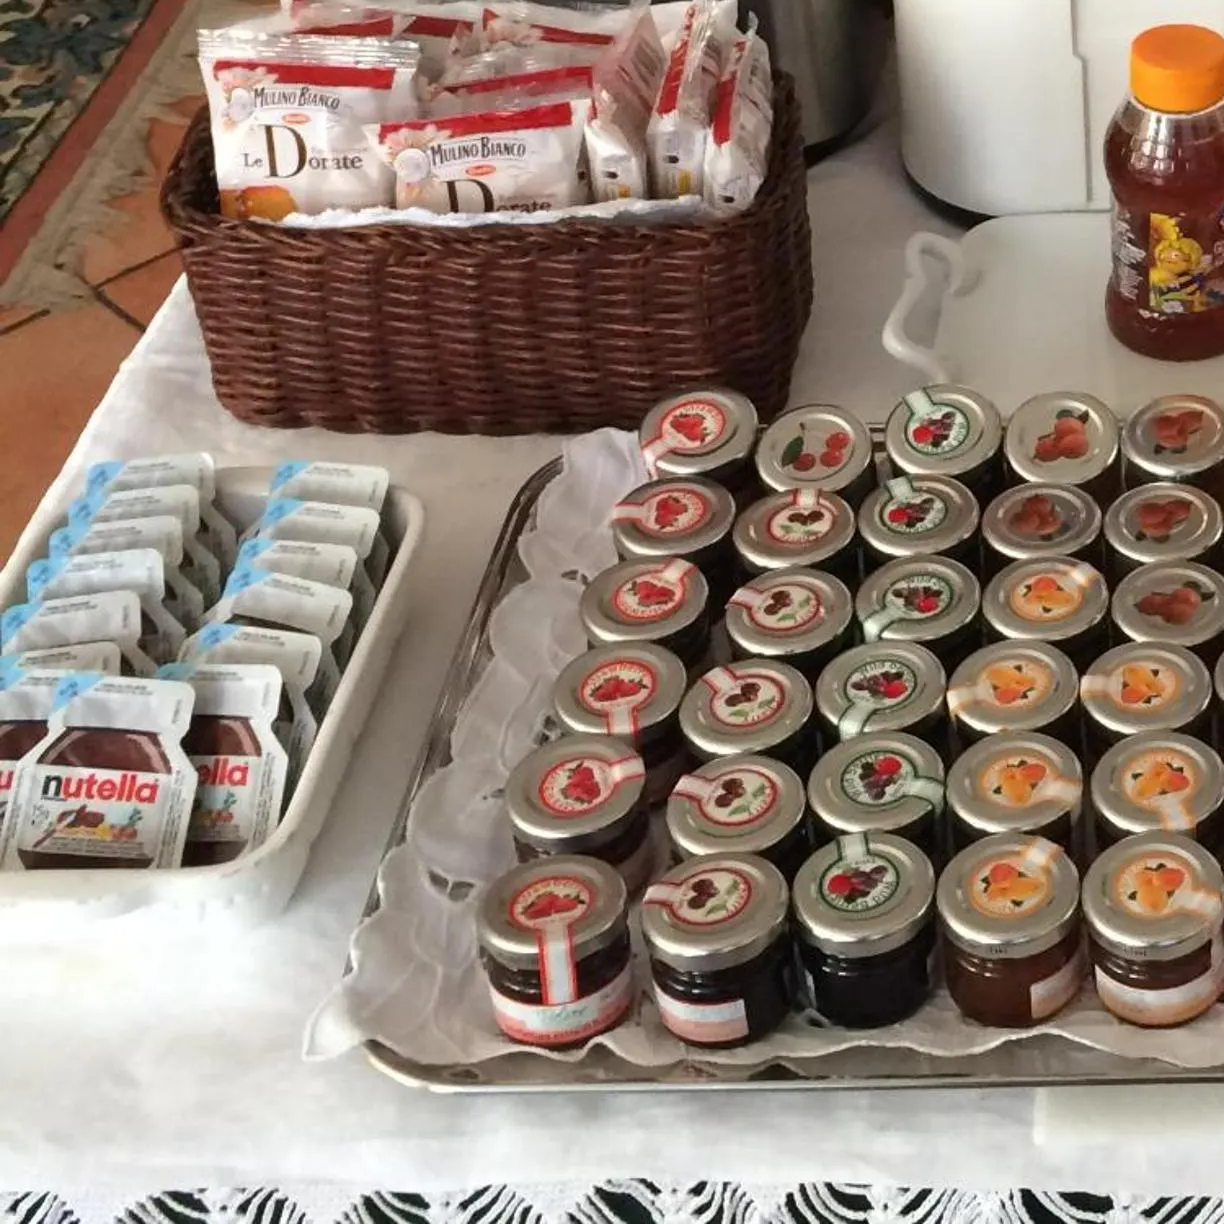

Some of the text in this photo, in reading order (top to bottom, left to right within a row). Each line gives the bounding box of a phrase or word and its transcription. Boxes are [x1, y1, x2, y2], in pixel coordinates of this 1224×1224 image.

[253, 87, 341, 110] MULINO BIANCO
[243, 152, 263, 169] Le
[430, 136, 527, 166] MULINO BIANCO
[197, 757, 250, 786] ella
[41, 772, 160, 804] nutella
